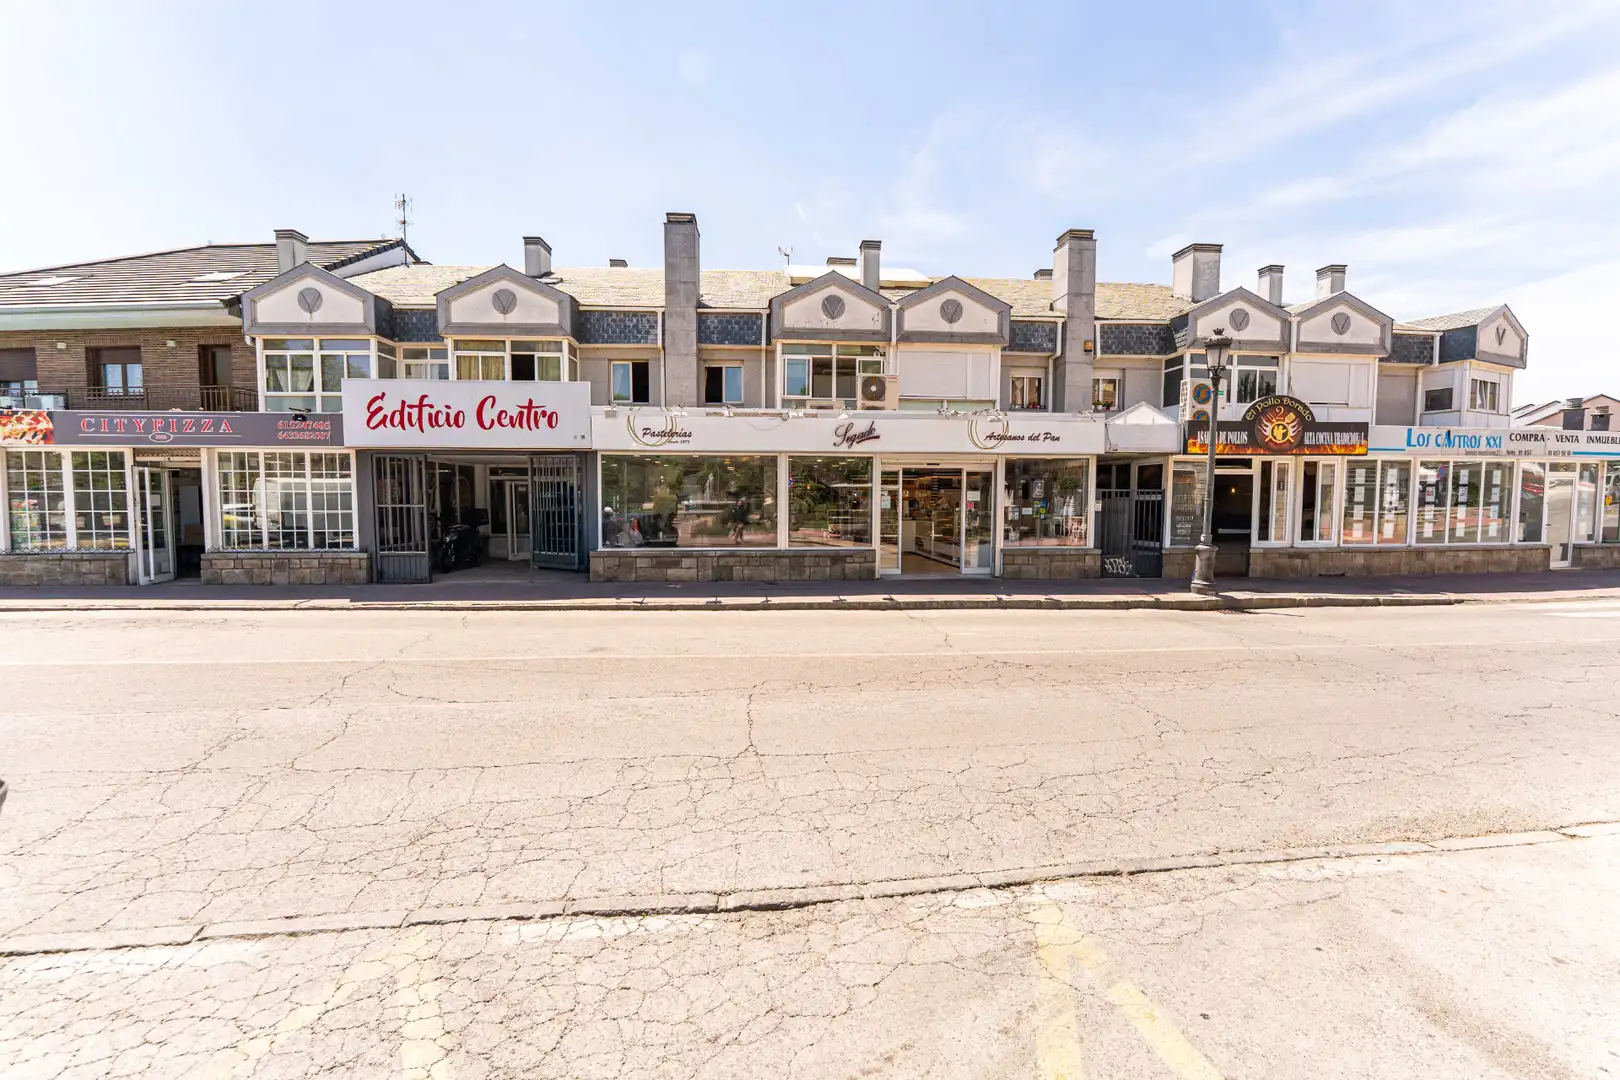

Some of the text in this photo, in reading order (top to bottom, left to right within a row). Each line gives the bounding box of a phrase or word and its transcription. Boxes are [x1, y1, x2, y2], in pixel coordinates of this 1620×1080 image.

[366, 391, 559, 433] Edificio Centro
[1255, 397, 1281, 413] Pollo
[1282, 396, 1312, 421] Dorado
[1275, 405, 1285, 420] 2
[642, 427, 692, 438] Pastelerías
[832, 420, 880, 449] Segado
[984, 431, 1061, 443] Artesanos del Pan
[1219, 430, 1227, 444] DE
[1227, 431, 1248, 445] POLLOS
[1304, 431, 1316, 444] ALTA
[1316, 431, 1333, 444] COCINA
[1509, 432, 1545, 442] COMPRA
[1555, 434, 1580, 444] VENTA
[1485, 435, 1502, 449] XXI
